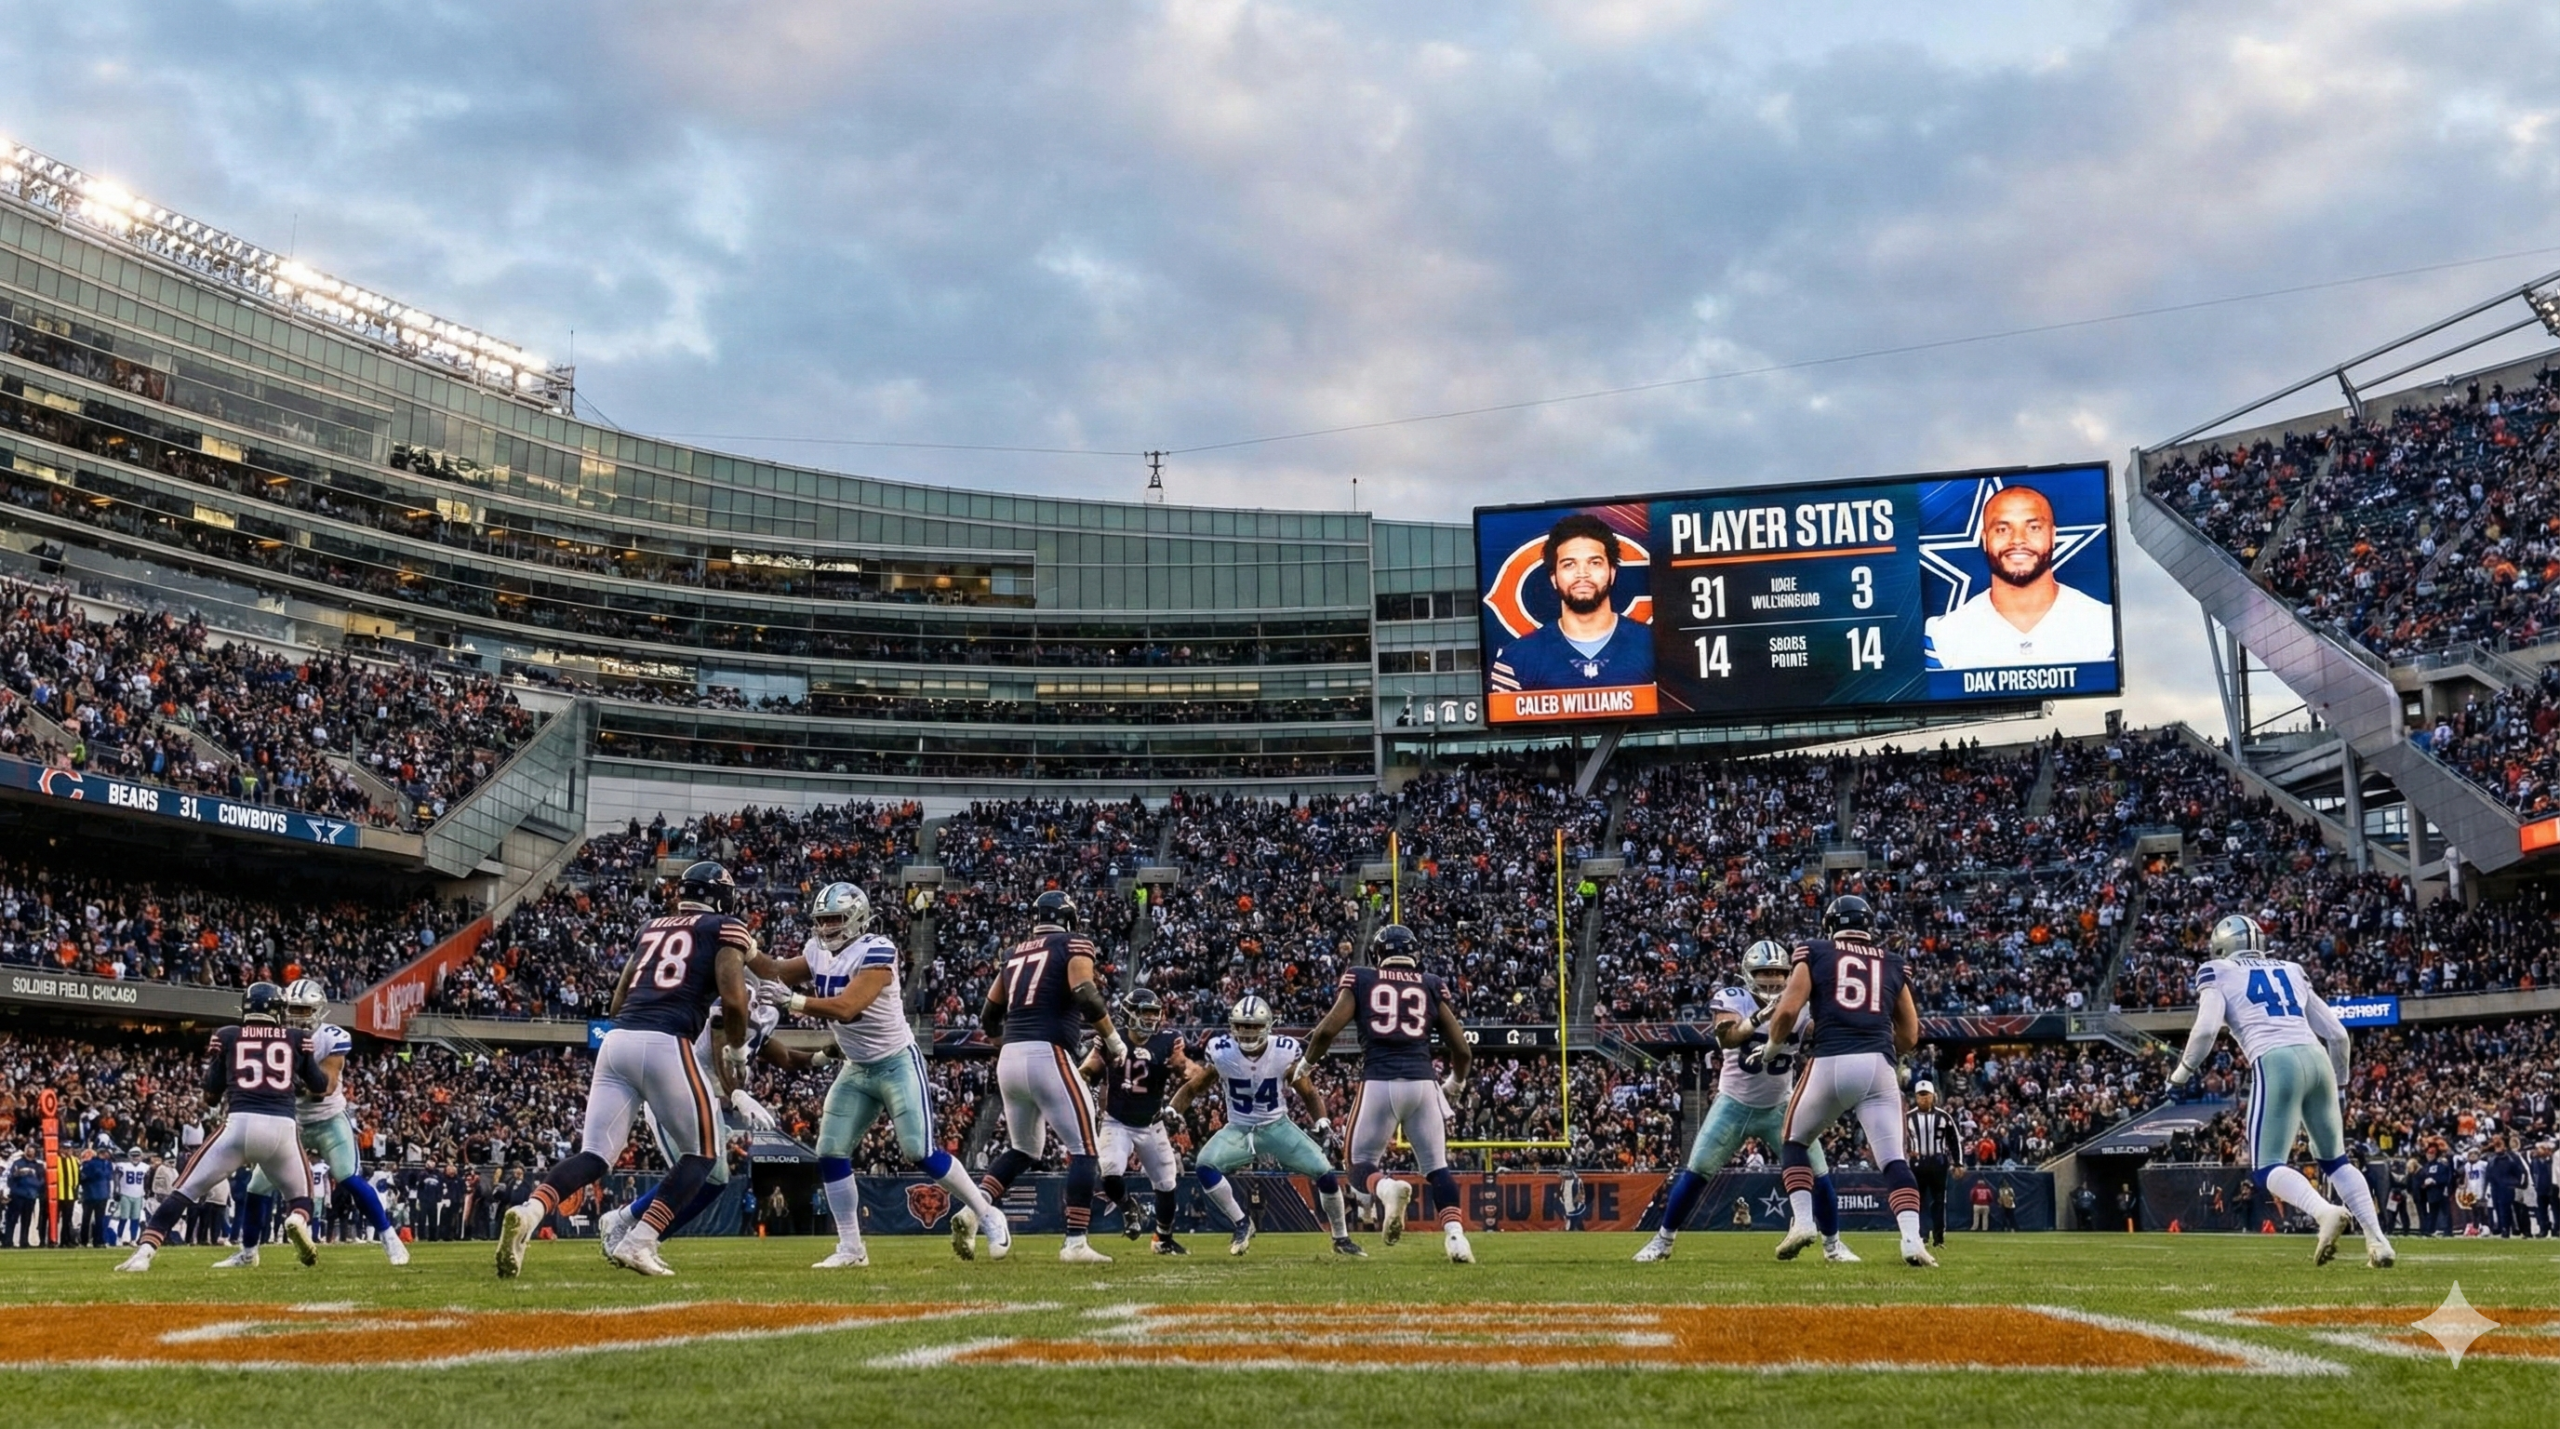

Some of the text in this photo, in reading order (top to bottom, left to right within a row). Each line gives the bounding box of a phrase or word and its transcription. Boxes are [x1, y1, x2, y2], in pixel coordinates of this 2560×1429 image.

[1671, 499, 1894, 555] PLAYER STATS
[1691, 575, 1726, 619] 31
[1851, 566, 1874, 609] 3
[1694, 635, 1732, 678] 14
[1846, 626, 1885, 671] 14
[1963, 667, 2077, 692] DAK PRESCOTT
[1516, 690, 1633, 716] CALEB WILLIAMS
[109, 783, 287, 833] BEARS 31, COWBOYS
[629, 930, 692, 988] 78
[1006, 951, 1049, 1012] 77
[12, 977, 56, 996] SOLDIER
[92, 984, 137, 1004] CHICAGO
[1836, 956, 1882, 1012] 61
[2246, 969, 2304, 1017] 41
[1370, 984, 1427, 1037] 93
[236, 1041, 293, 1090] 59
[1228, 1077, 1279, 1114] 54
